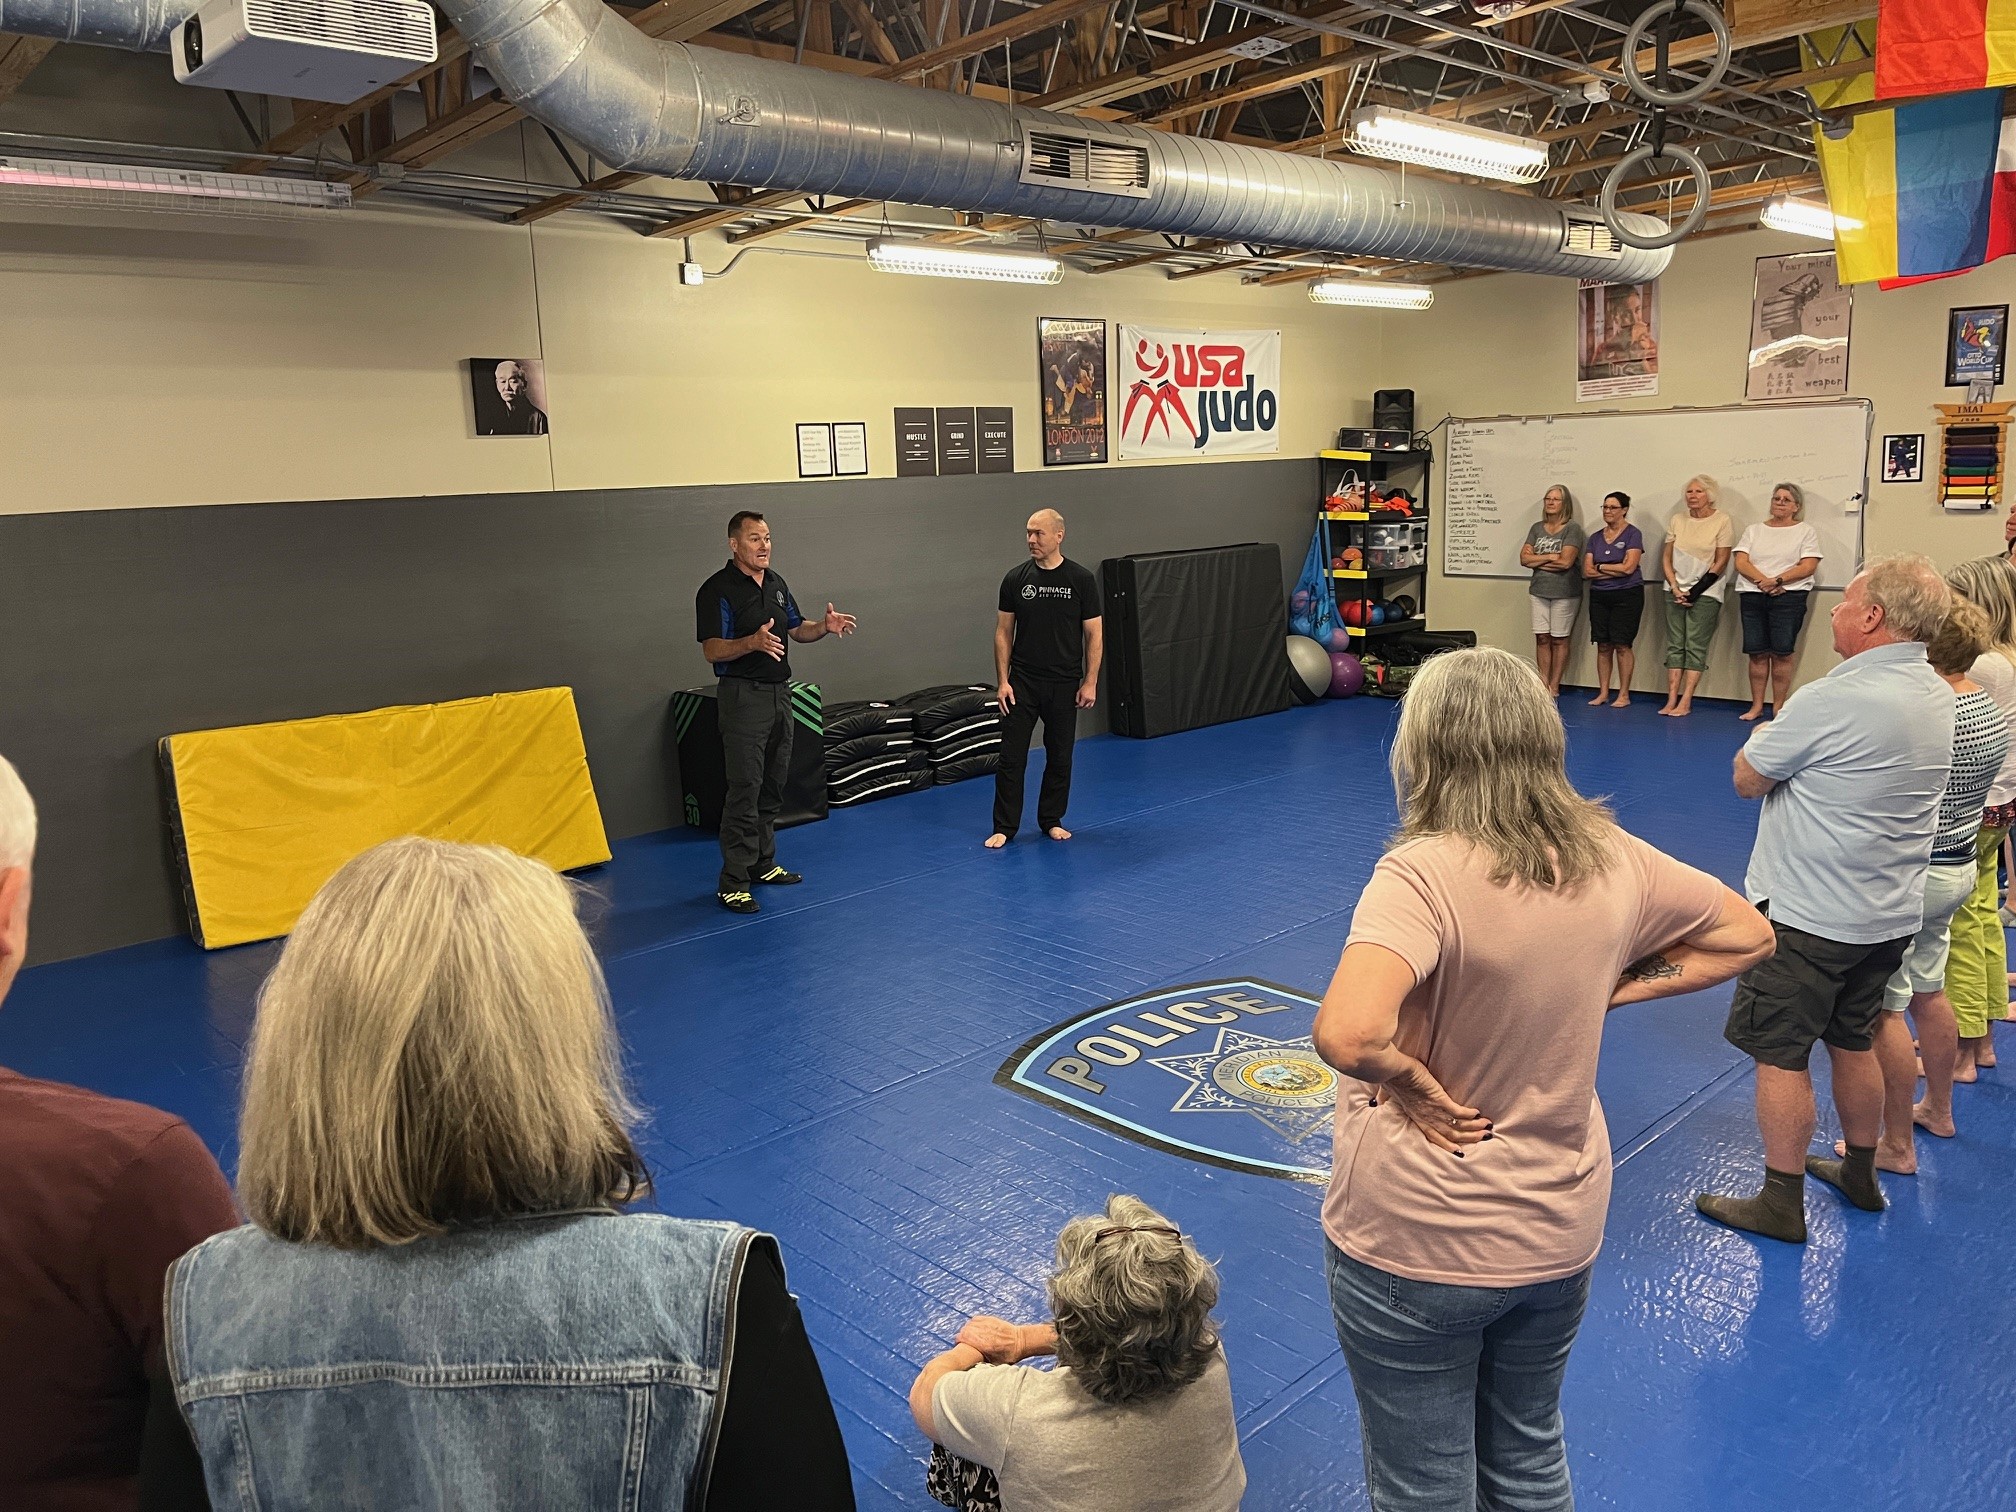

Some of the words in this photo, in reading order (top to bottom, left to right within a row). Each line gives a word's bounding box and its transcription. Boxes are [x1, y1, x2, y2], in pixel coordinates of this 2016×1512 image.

[1778, 260, 1801, 272] Your
[1808, 258, 1832, 269] mind
[1834, 282, 1843, 292] is
[1815, 314, 1840, 326] your
[1818, 353, 1842, 365] best
[1805, 378, 1843, 390] weapon
[1194, 374, 1277, 449] judo
[1957, 405, 1984, 414] IMAI
[906, 433, 927, 441] HUSTLE
[984, 431, 1007, 439] EXECUTE
[1047, 428, 1084, 446] LONDON
[1085, 427, 1105, 444] 2012
[1039, 586, 1072, 595] PINNACLE
[685, 804, 700, 827] 30
[1045, 992, 1292, 1095] POLICE
[1219, 1050, 1282, 1081] MERIDIAN
[1239, 1090, 1309, 1107] POLICE
